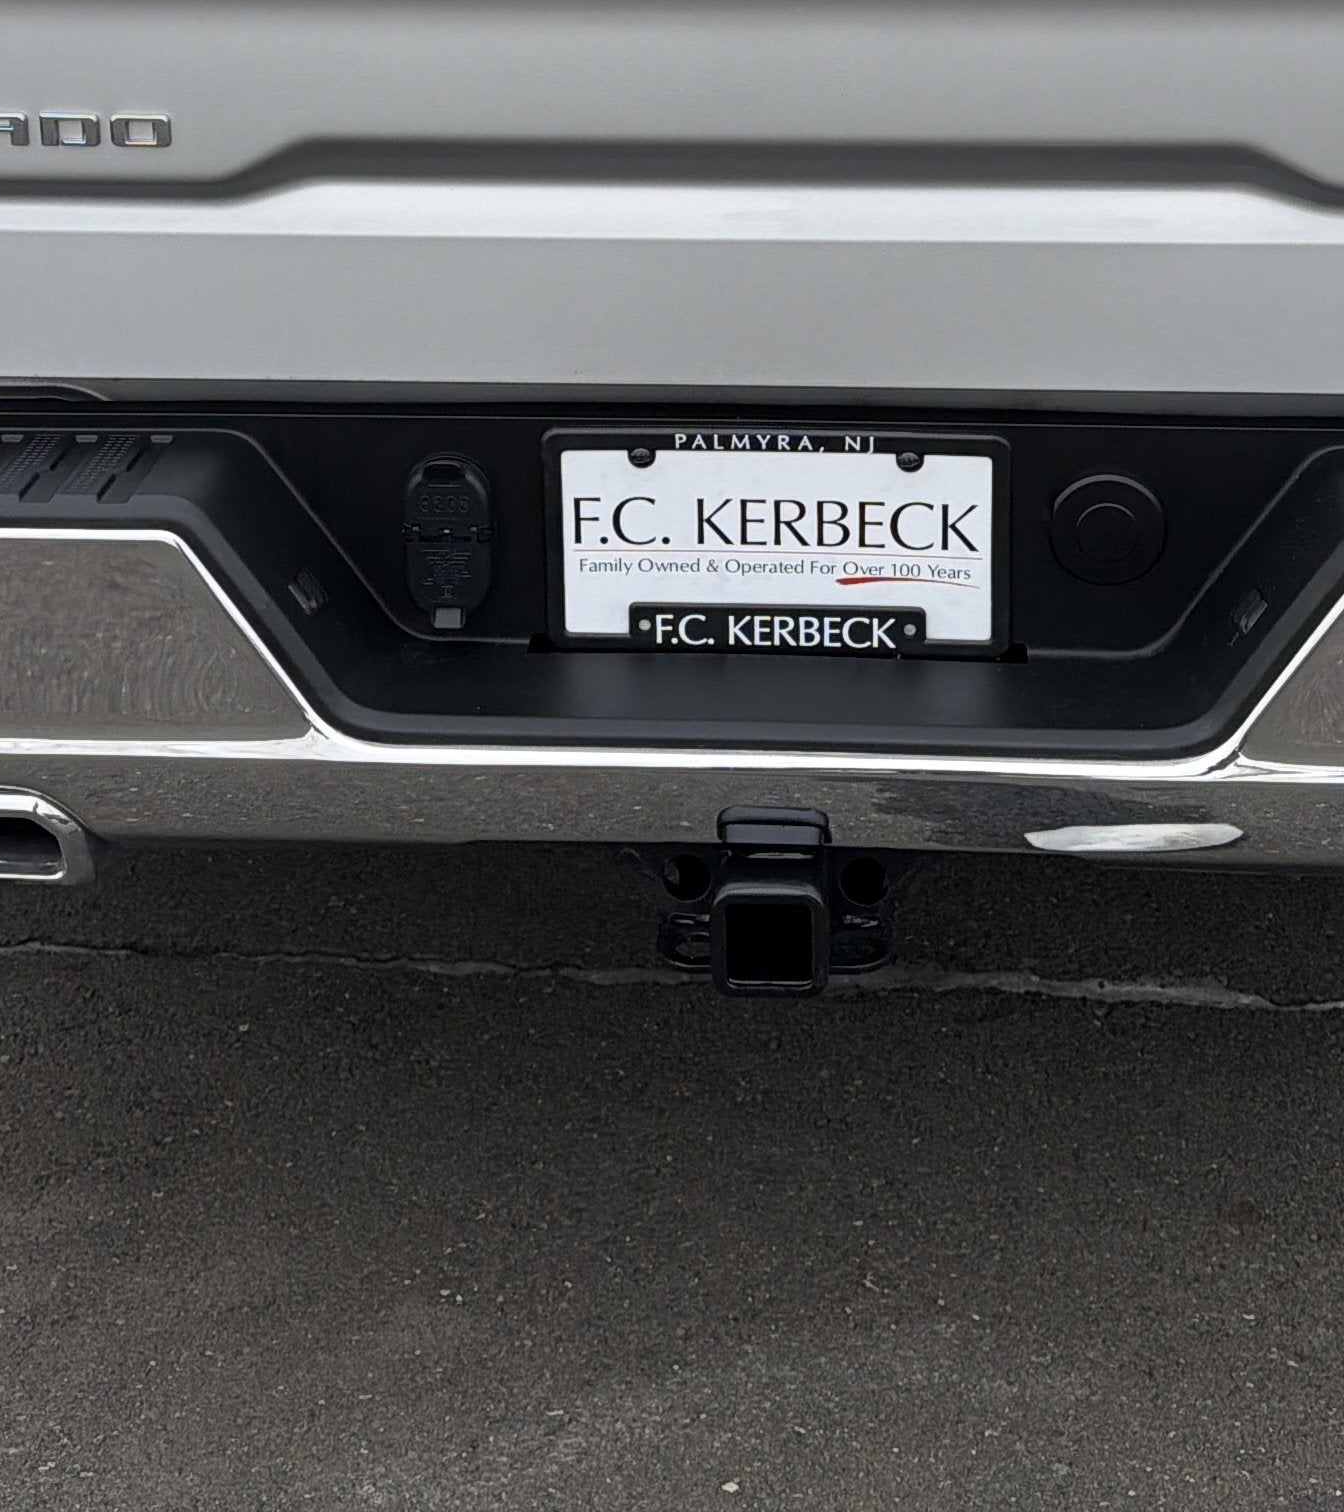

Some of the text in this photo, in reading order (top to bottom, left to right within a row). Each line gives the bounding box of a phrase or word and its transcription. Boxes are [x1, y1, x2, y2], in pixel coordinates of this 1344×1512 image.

[674, 433, 877, 454] PALMYRA, NJ
[572, 496, 980, 553] F.C. KERBECK
[579, 557, 972, 580] Family Owned & Operated For Over 100 Years
[655, 614, 896, 649] F.C. KERBECK
